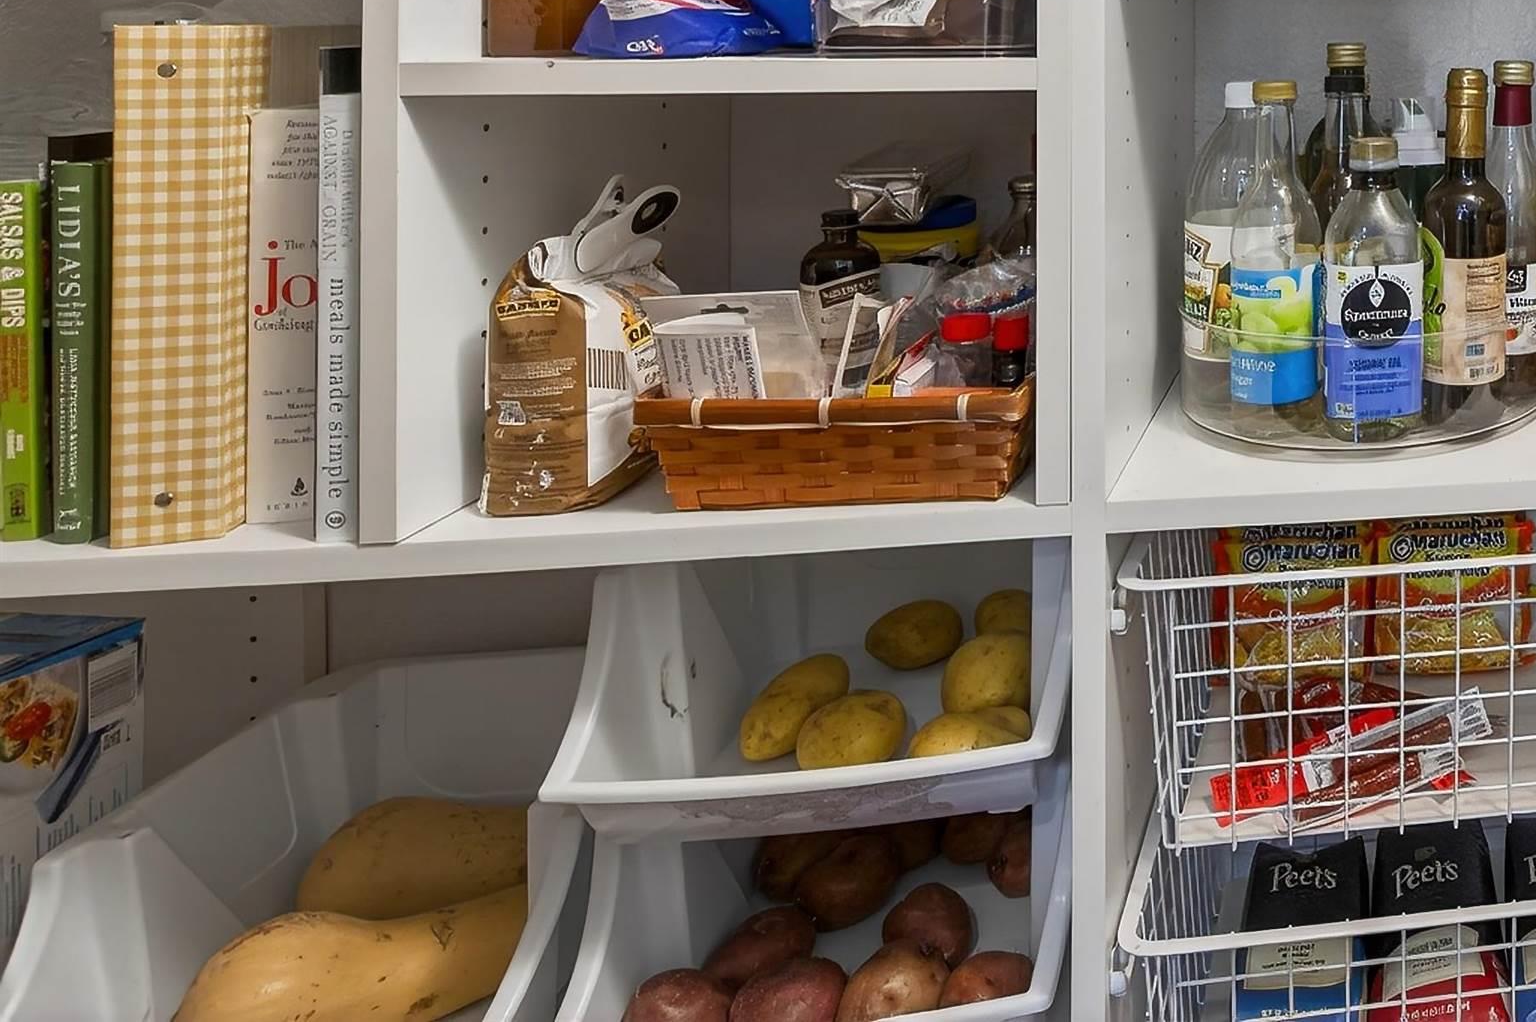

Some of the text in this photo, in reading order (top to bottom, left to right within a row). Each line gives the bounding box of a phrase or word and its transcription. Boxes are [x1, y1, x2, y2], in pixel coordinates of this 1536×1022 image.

[0, 192, 26, 328] SALSAS & DIPS
[58, 185, 81, 297] LIDIA'S
[322, 277, 352, 499] meals made simple
[1264, 542, 1361, 562] Maruchan
[1269, 862, 1338, 893] Peet's
[1392, 859, 1459, 899] Peet's
